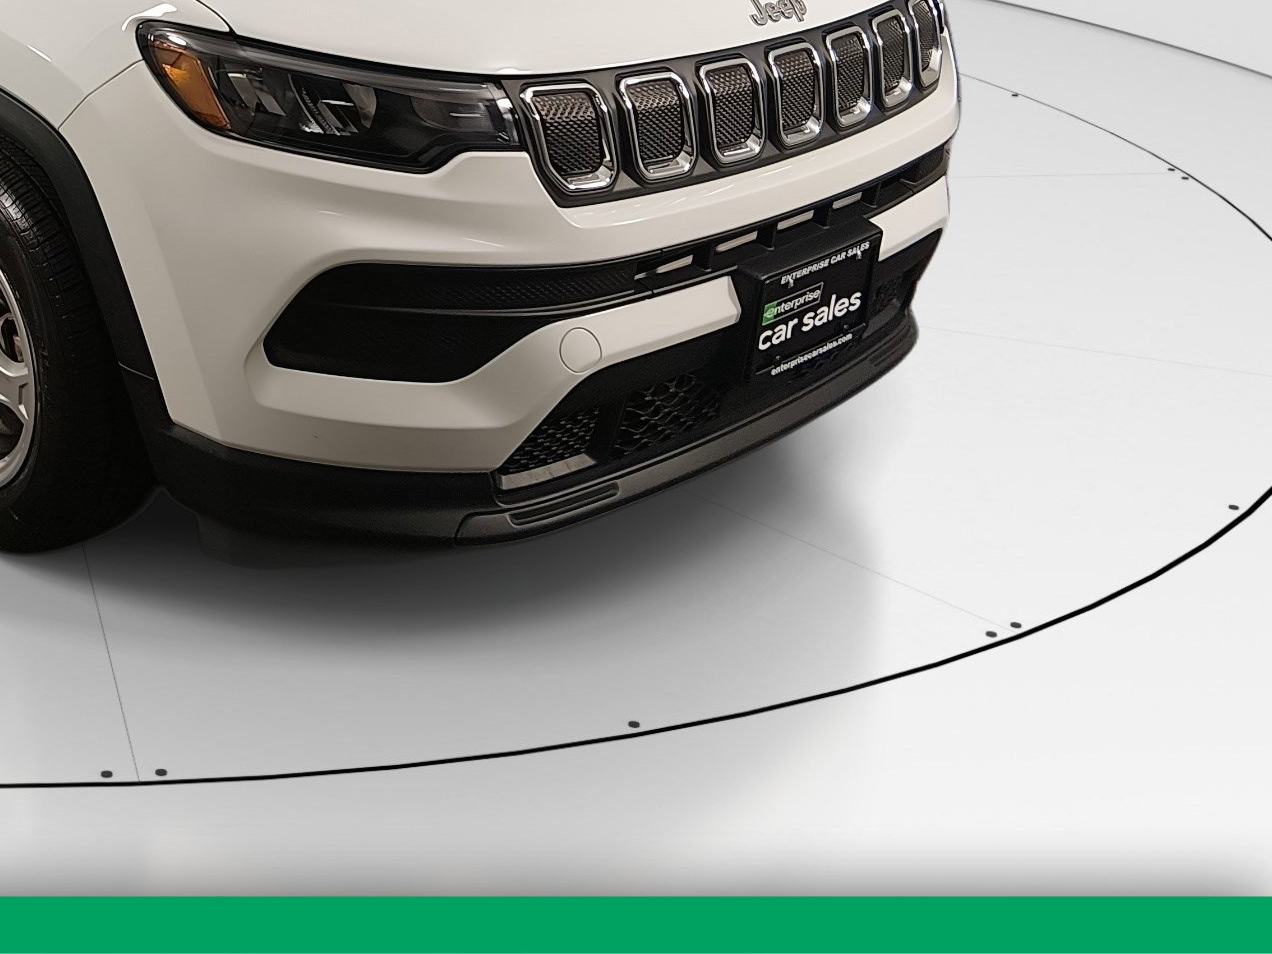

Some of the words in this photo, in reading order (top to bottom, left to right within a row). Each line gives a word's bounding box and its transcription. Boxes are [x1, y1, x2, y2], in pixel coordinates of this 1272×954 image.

[781, 259, 830, 285] ENTERPRISE
[830, 252, 847, 265] CAR
[846, 241, 870, 258] SALES
[758, 318, 799, 351] car
[801, 291, 862, 332] sales
[763, 289, 821, 319] enterprise
[771, 333, 853, 376] enterprisecarsales.com
